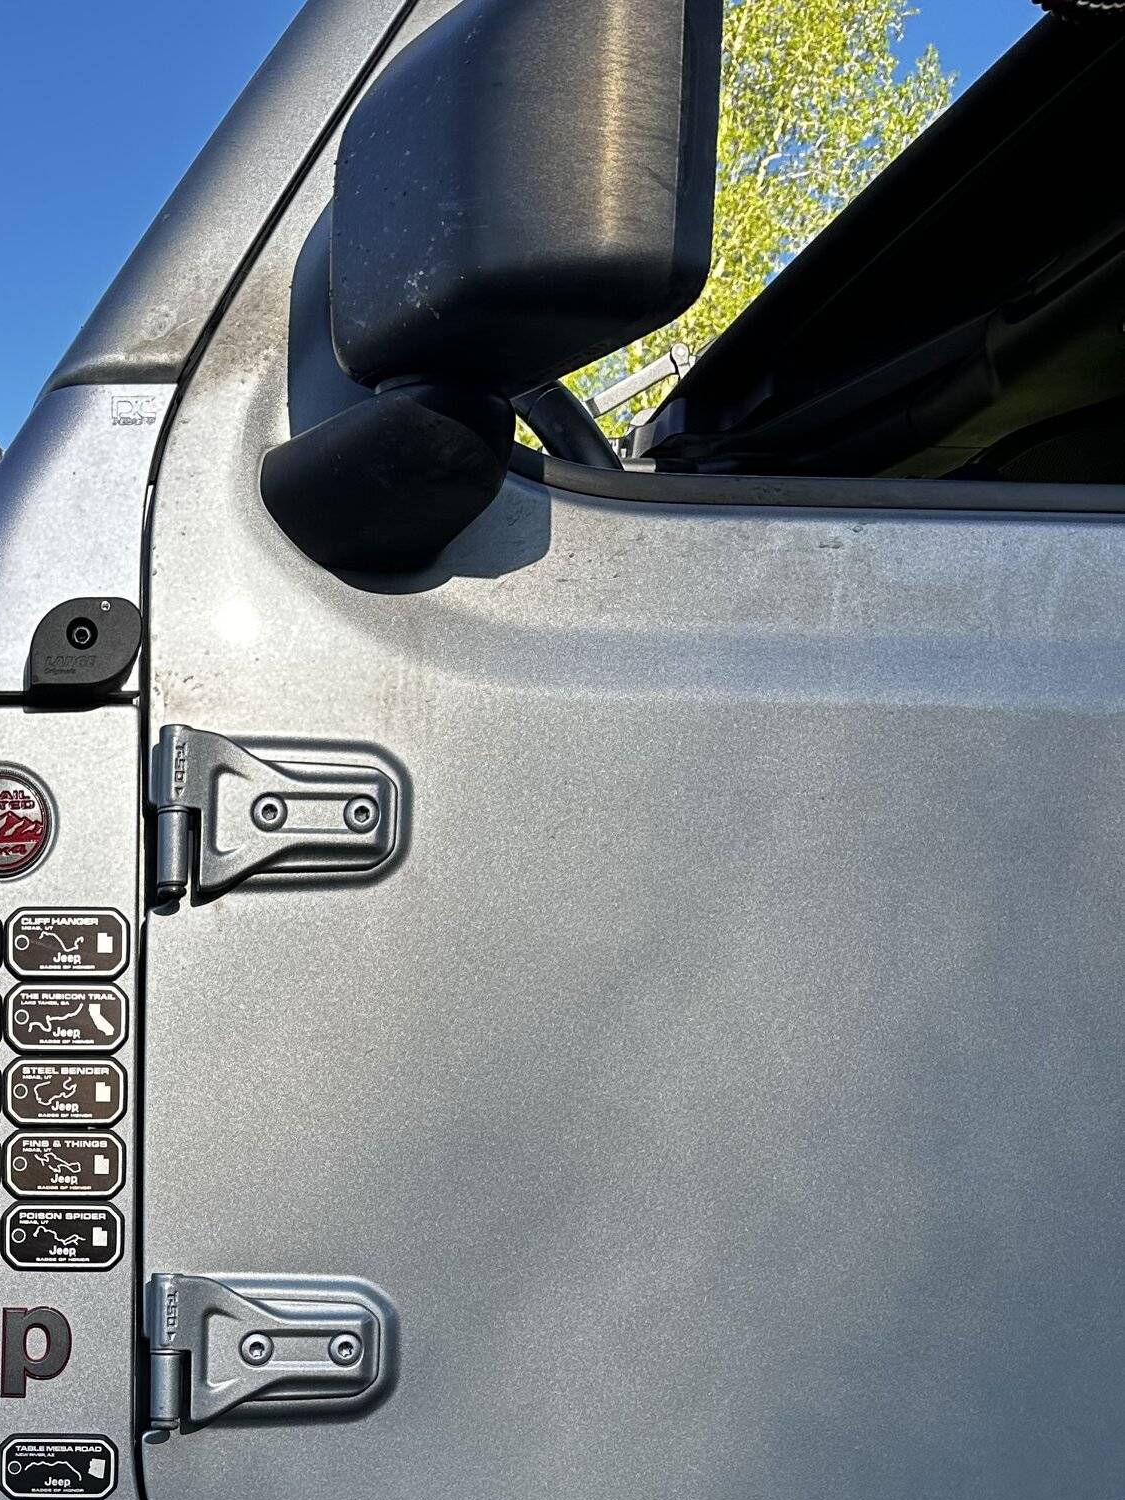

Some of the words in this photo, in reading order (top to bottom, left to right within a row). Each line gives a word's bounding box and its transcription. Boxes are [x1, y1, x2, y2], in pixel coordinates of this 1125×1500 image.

[53, 952, 81, 964] Jeep
[53, 1027, 80, 1039] Jeep
[61, 1067, 109, 1075] BENDER
[51, 1101, 79, 1112] Jeep
[51, 1174, 78, 1184] Jeep
[49, 1246, 76, 1257] Jeep
[44, 1477, 71, 1487] Jeep
